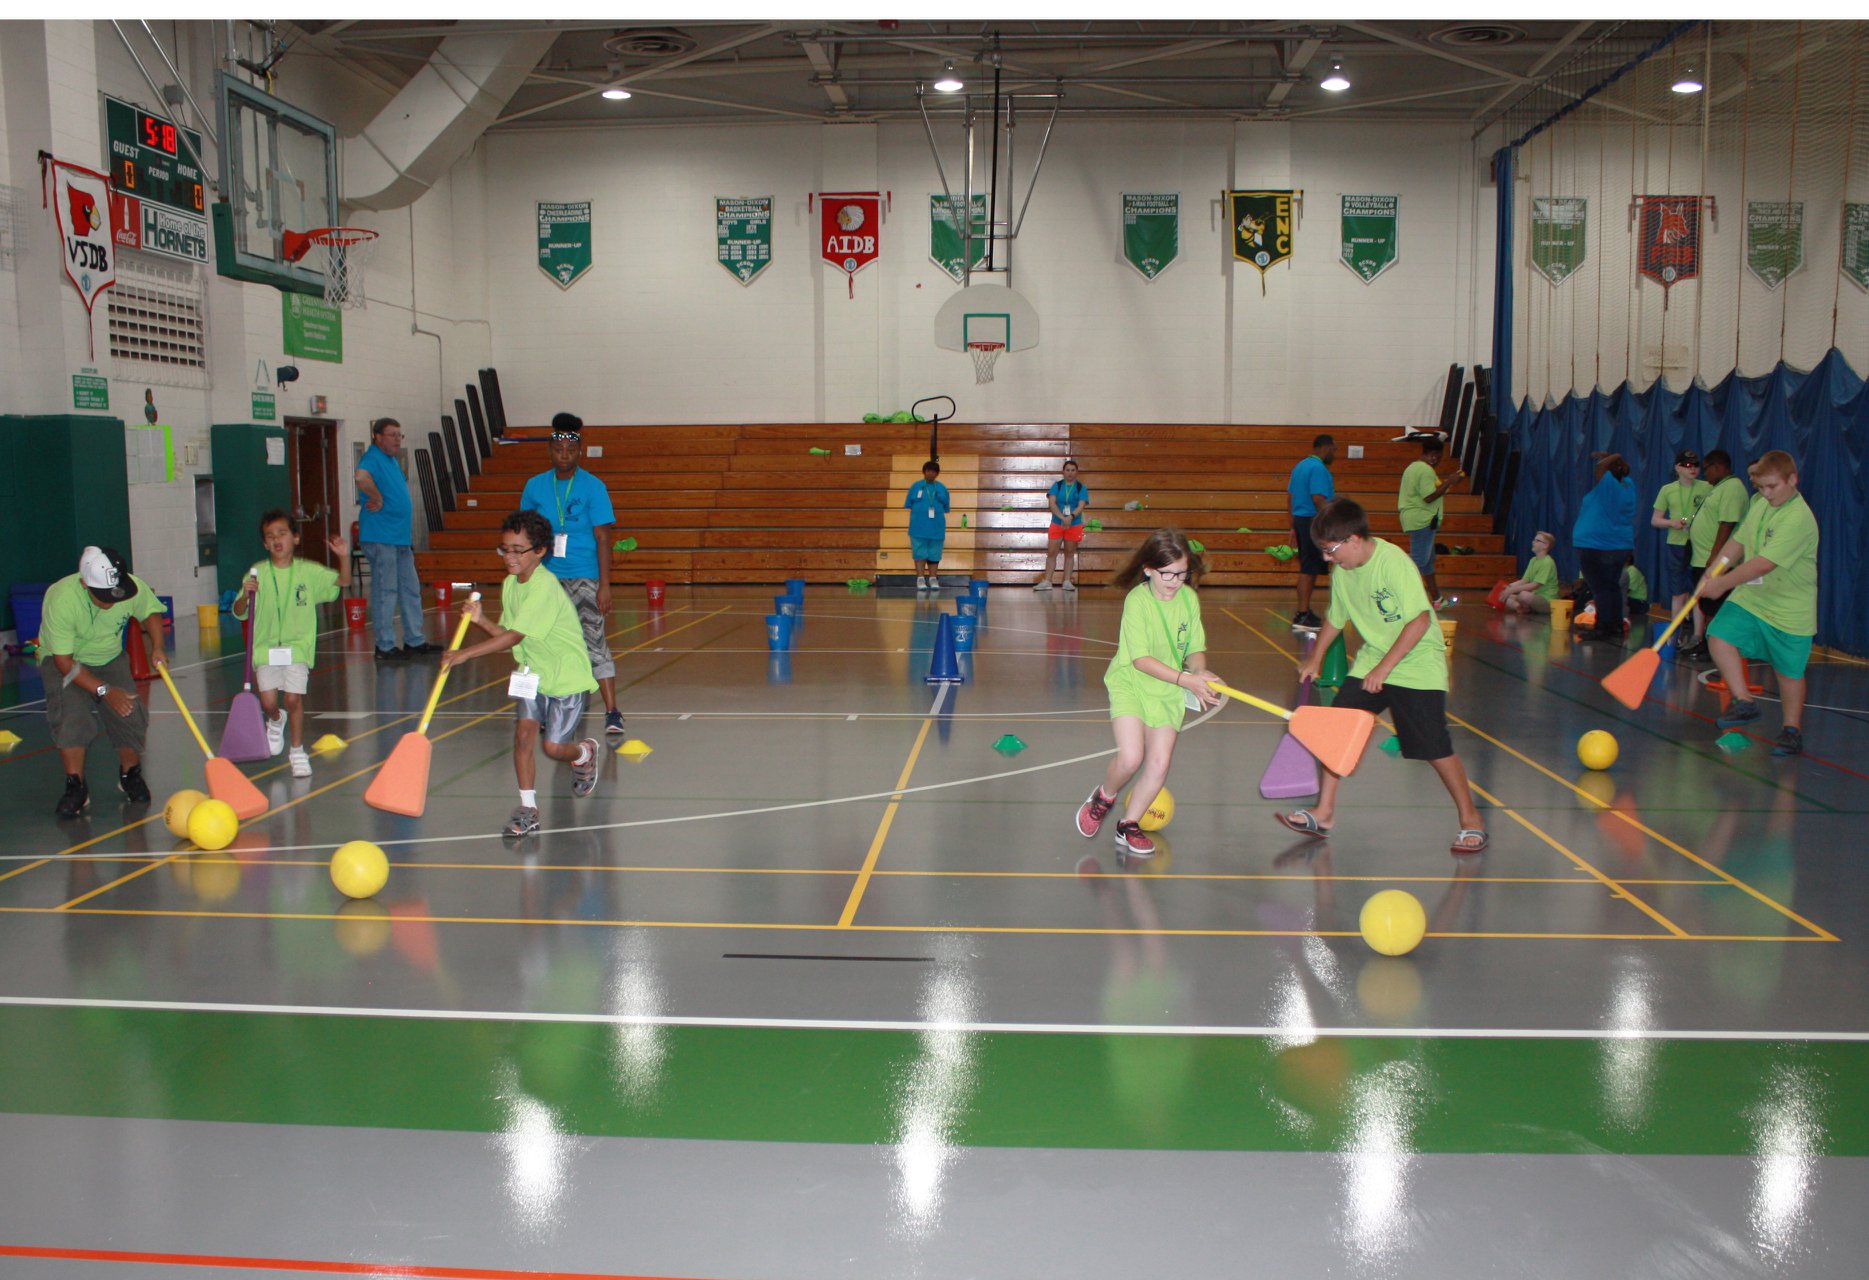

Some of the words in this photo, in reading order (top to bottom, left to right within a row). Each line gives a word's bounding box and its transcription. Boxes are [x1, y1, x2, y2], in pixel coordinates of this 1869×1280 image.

[145, 116, 176, 154] 5:18
[113, 141, 139, 159] GUEST
[148, 166, 169, 181] PERIOD
[177, 163, 198, 180] HOME
[539, 214, 590, 222] CHAMPIONS
[1125, 206, 1177, 214] CHAMPIONS
[1749, 214, 1802, 222] CHAMPIONS
[144, 207, 206, 260] HORNETS
[159, 212, 183, 234] Home
[183, 223, 193, 235] of
[193, 224, 206, 238] the
[1276, 197, 1290, 254] ENC
[827, 235, 875, 254] AIDB
[67, 236, 108, 272] VSDB
